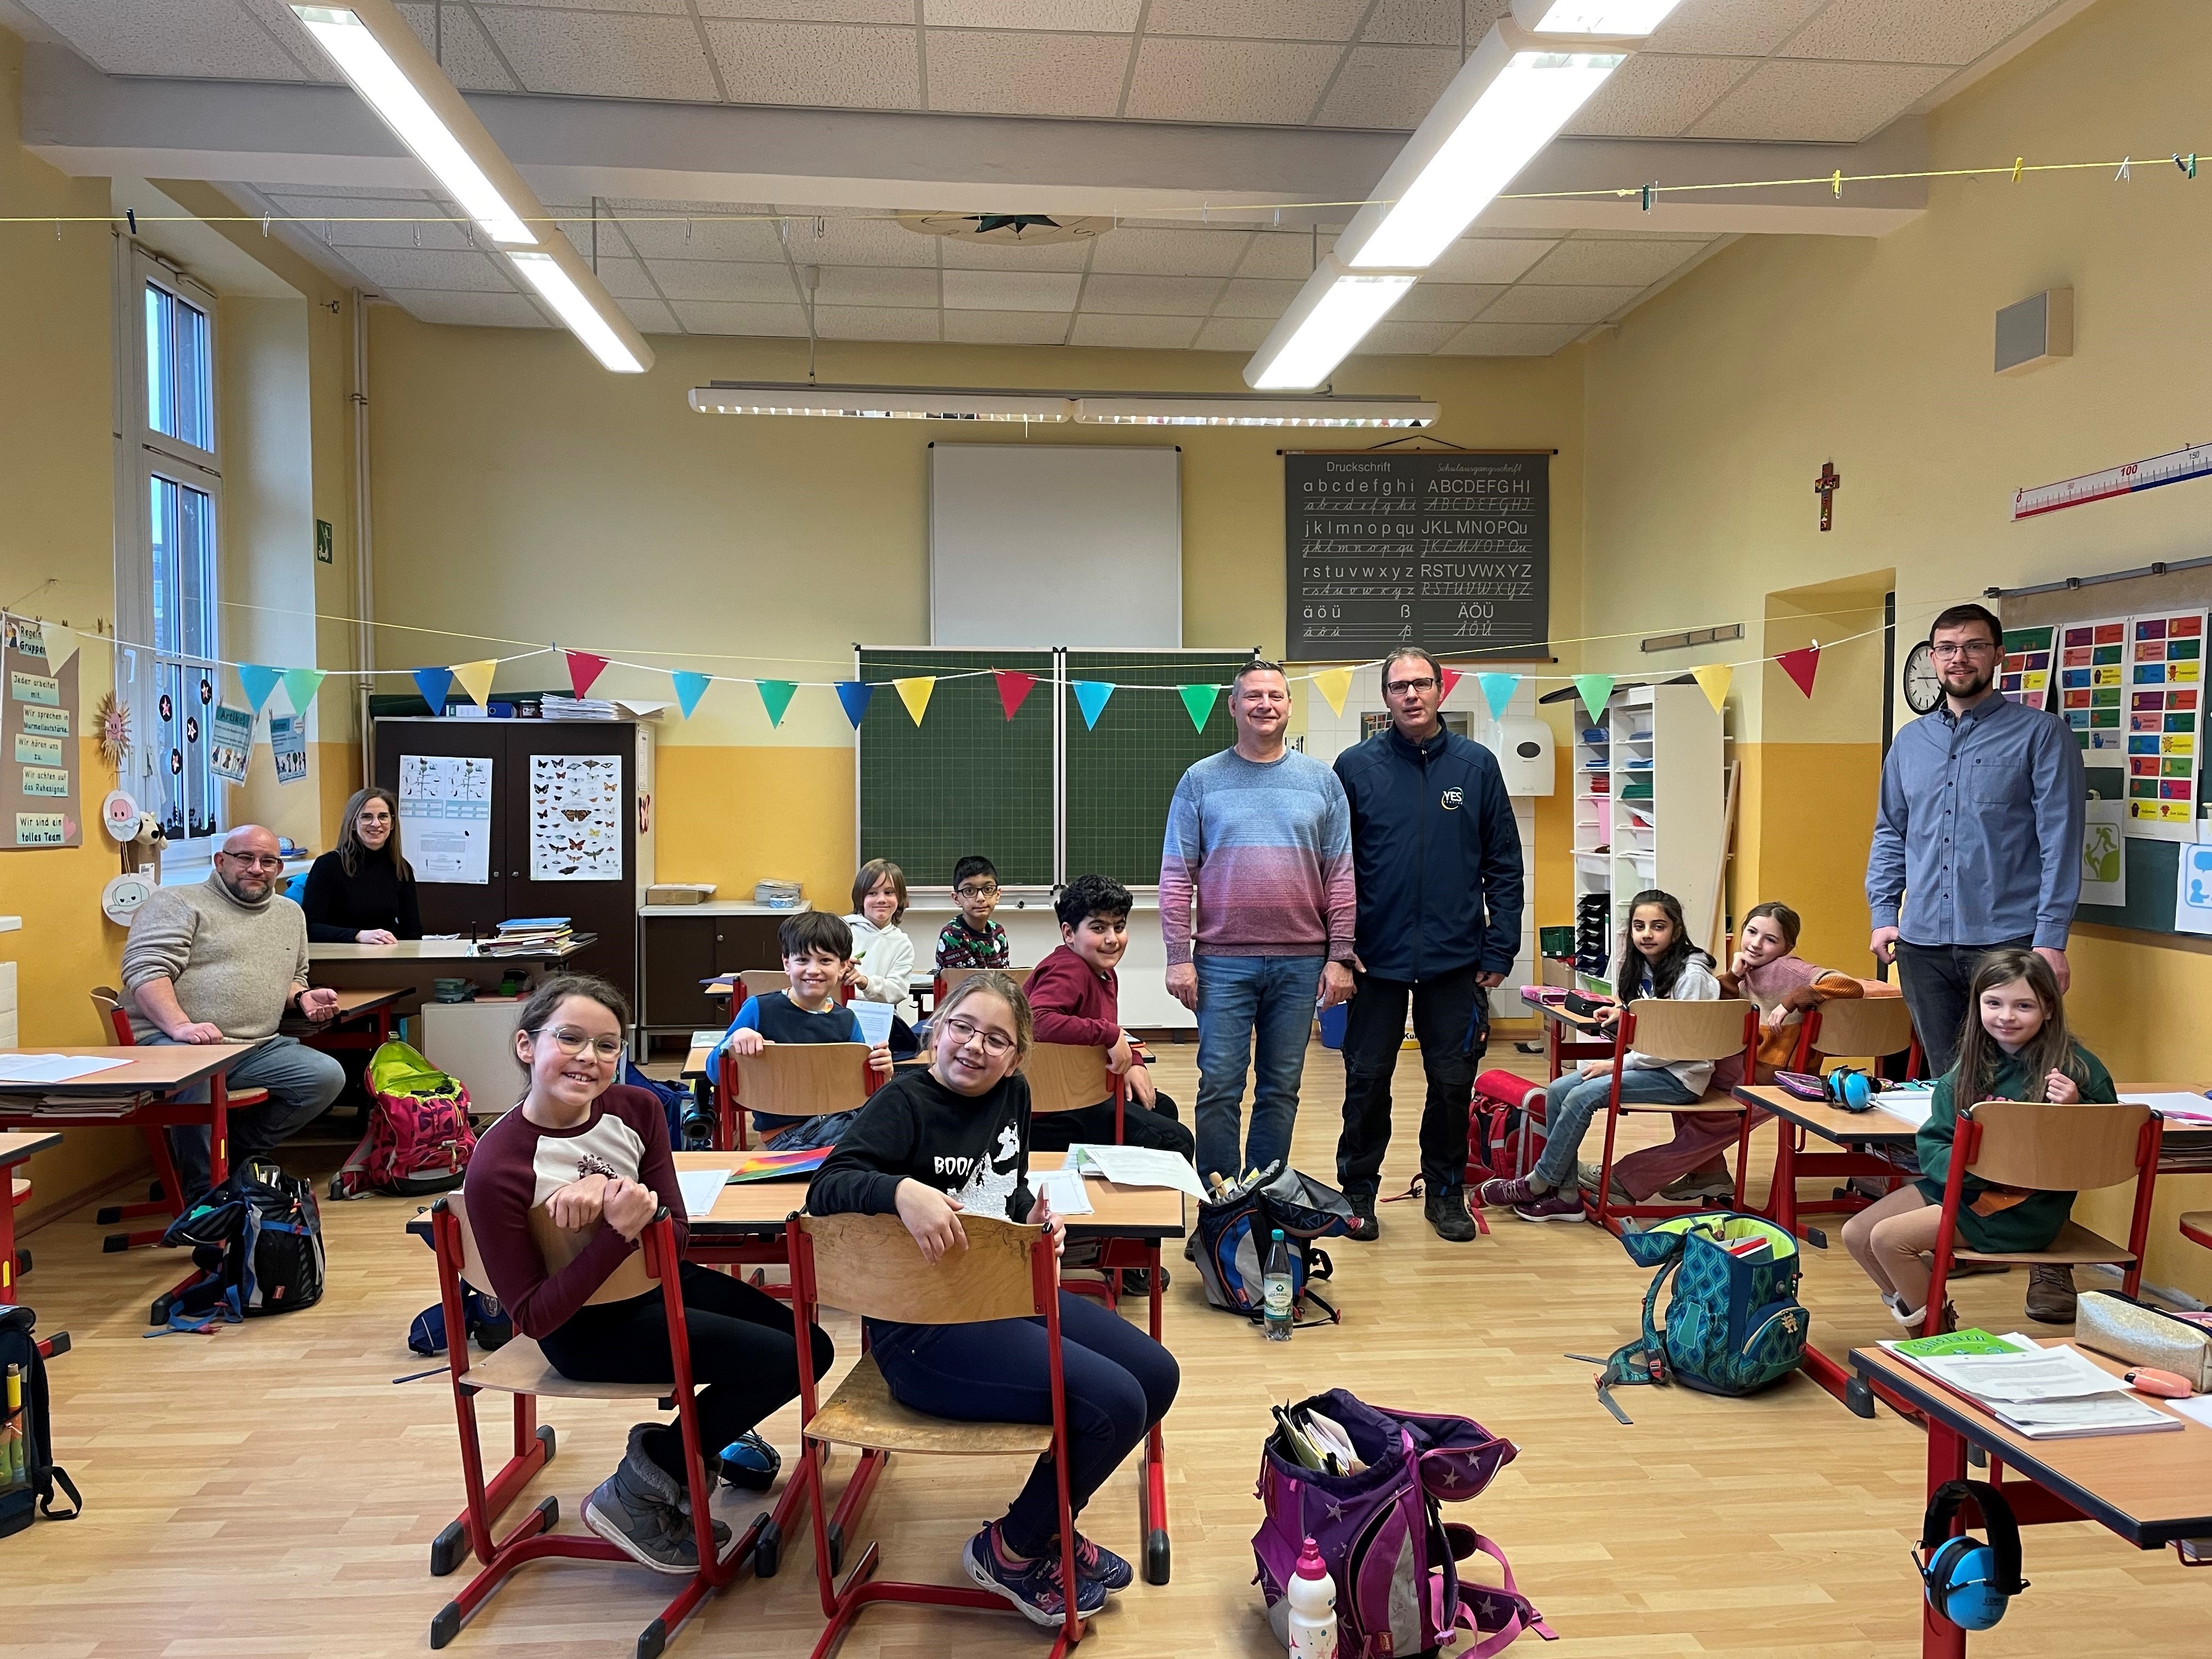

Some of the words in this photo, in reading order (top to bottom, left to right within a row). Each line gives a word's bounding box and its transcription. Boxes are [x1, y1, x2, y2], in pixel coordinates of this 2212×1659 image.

[1327, 461, 1391, 472] Druckschrift
[1437, 463, 1522, 476] Schulausgangsschrift
[2016, 493, 2022, 503] 0
[2120, 464, 2138, 477] 100
[2188, 450, 2200, 460] 150
[20, 625, 42, 639] Regeln
[14, 674, 31, 686] Jeder
[33, 679, 55, 690] arbeitet
[24, 708, 35, 717] Wir
[38, 711, 61, 720] sprechen
[221, 709, 246, 727] Artikel
[19, 737, 29, 746] Wir
[31, 739, 47, 749] hören
[25, 770, 35, 779] Wir
[37, 772, 56, 780] achten
[58, 773, 66, 781] auf
[1443, 791, 1462, 802] YES
[20, 816, 33, 827] Wir
[36, 817, 49, 827] sind
[53, 818, 63, 827] ein
[21, 832, 42, 843] tolles
[44, 832, 61, 842] Team
[934, 1156, 974, 1177] BOO!
